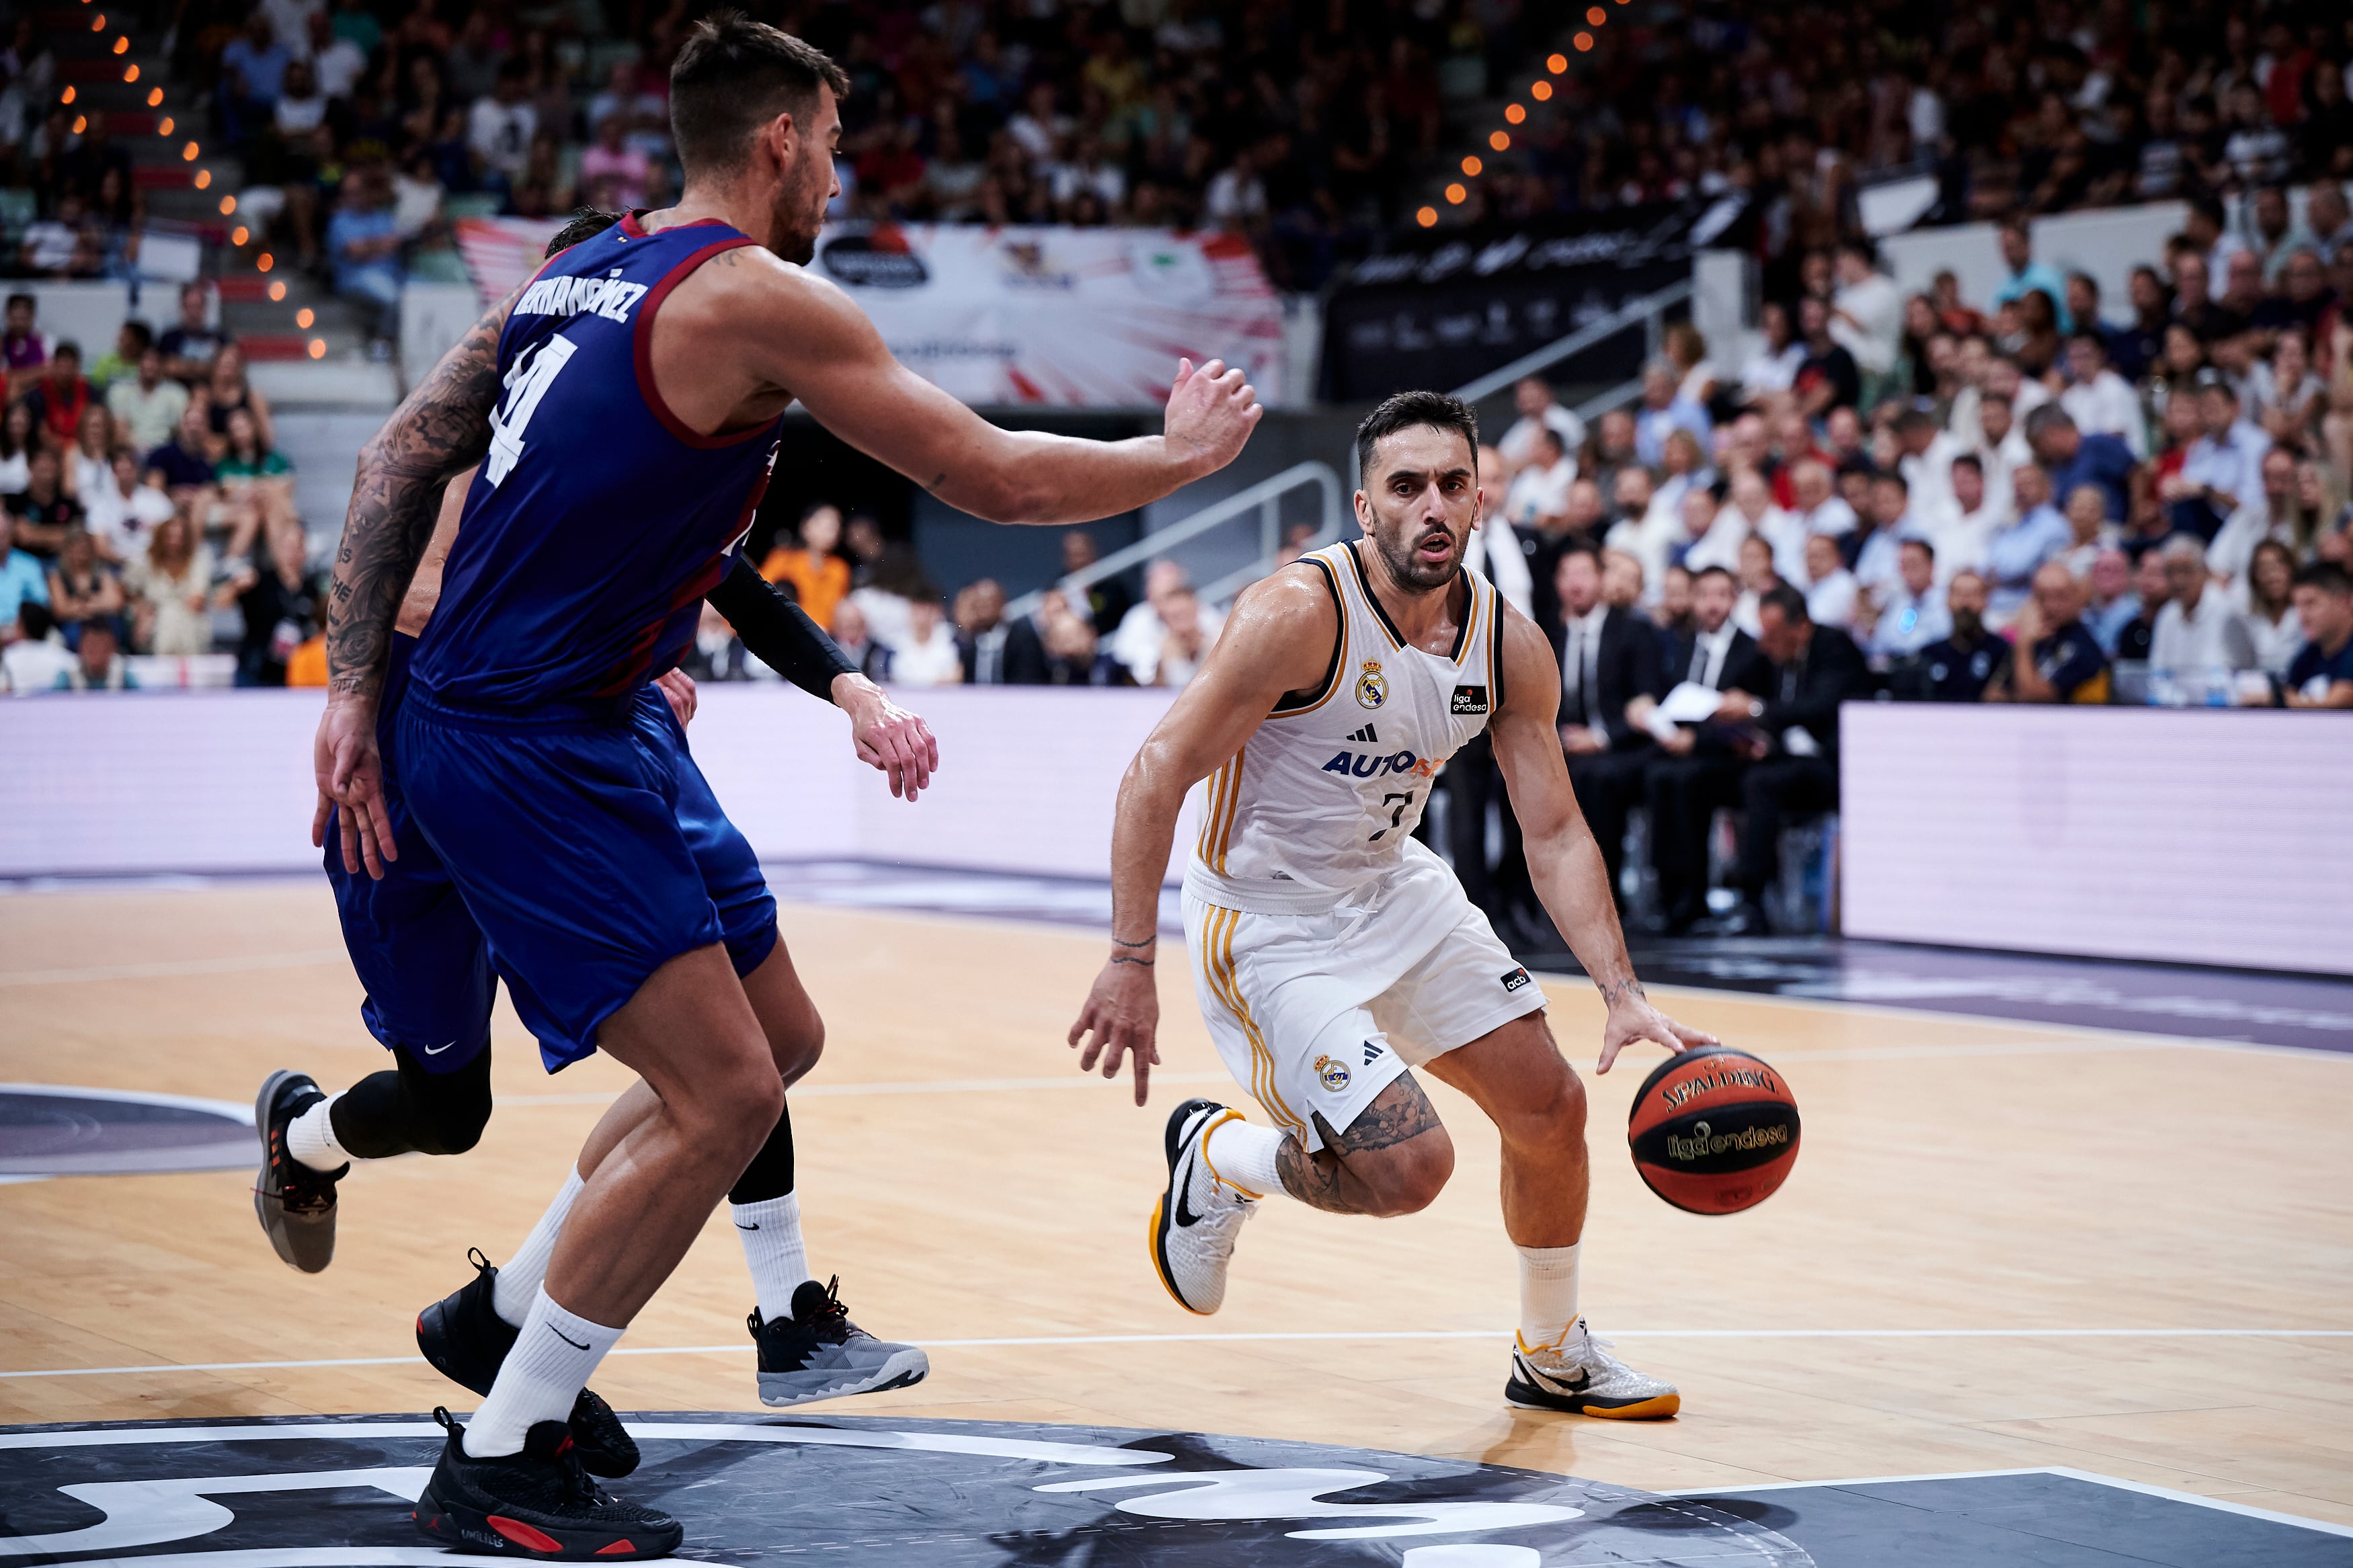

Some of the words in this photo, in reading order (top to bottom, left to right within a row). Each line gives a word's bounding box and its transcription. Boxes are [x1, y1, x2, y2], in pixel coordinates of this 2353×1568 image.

[1453, 694, 1471, 704] liga
[1453, 702, 1487, 712] endesa
[1368, 790, 1414, 842] 7
[1507, 975, 1526, 990] acb
[1661, 1067, 1776, 1114] SPALDING
